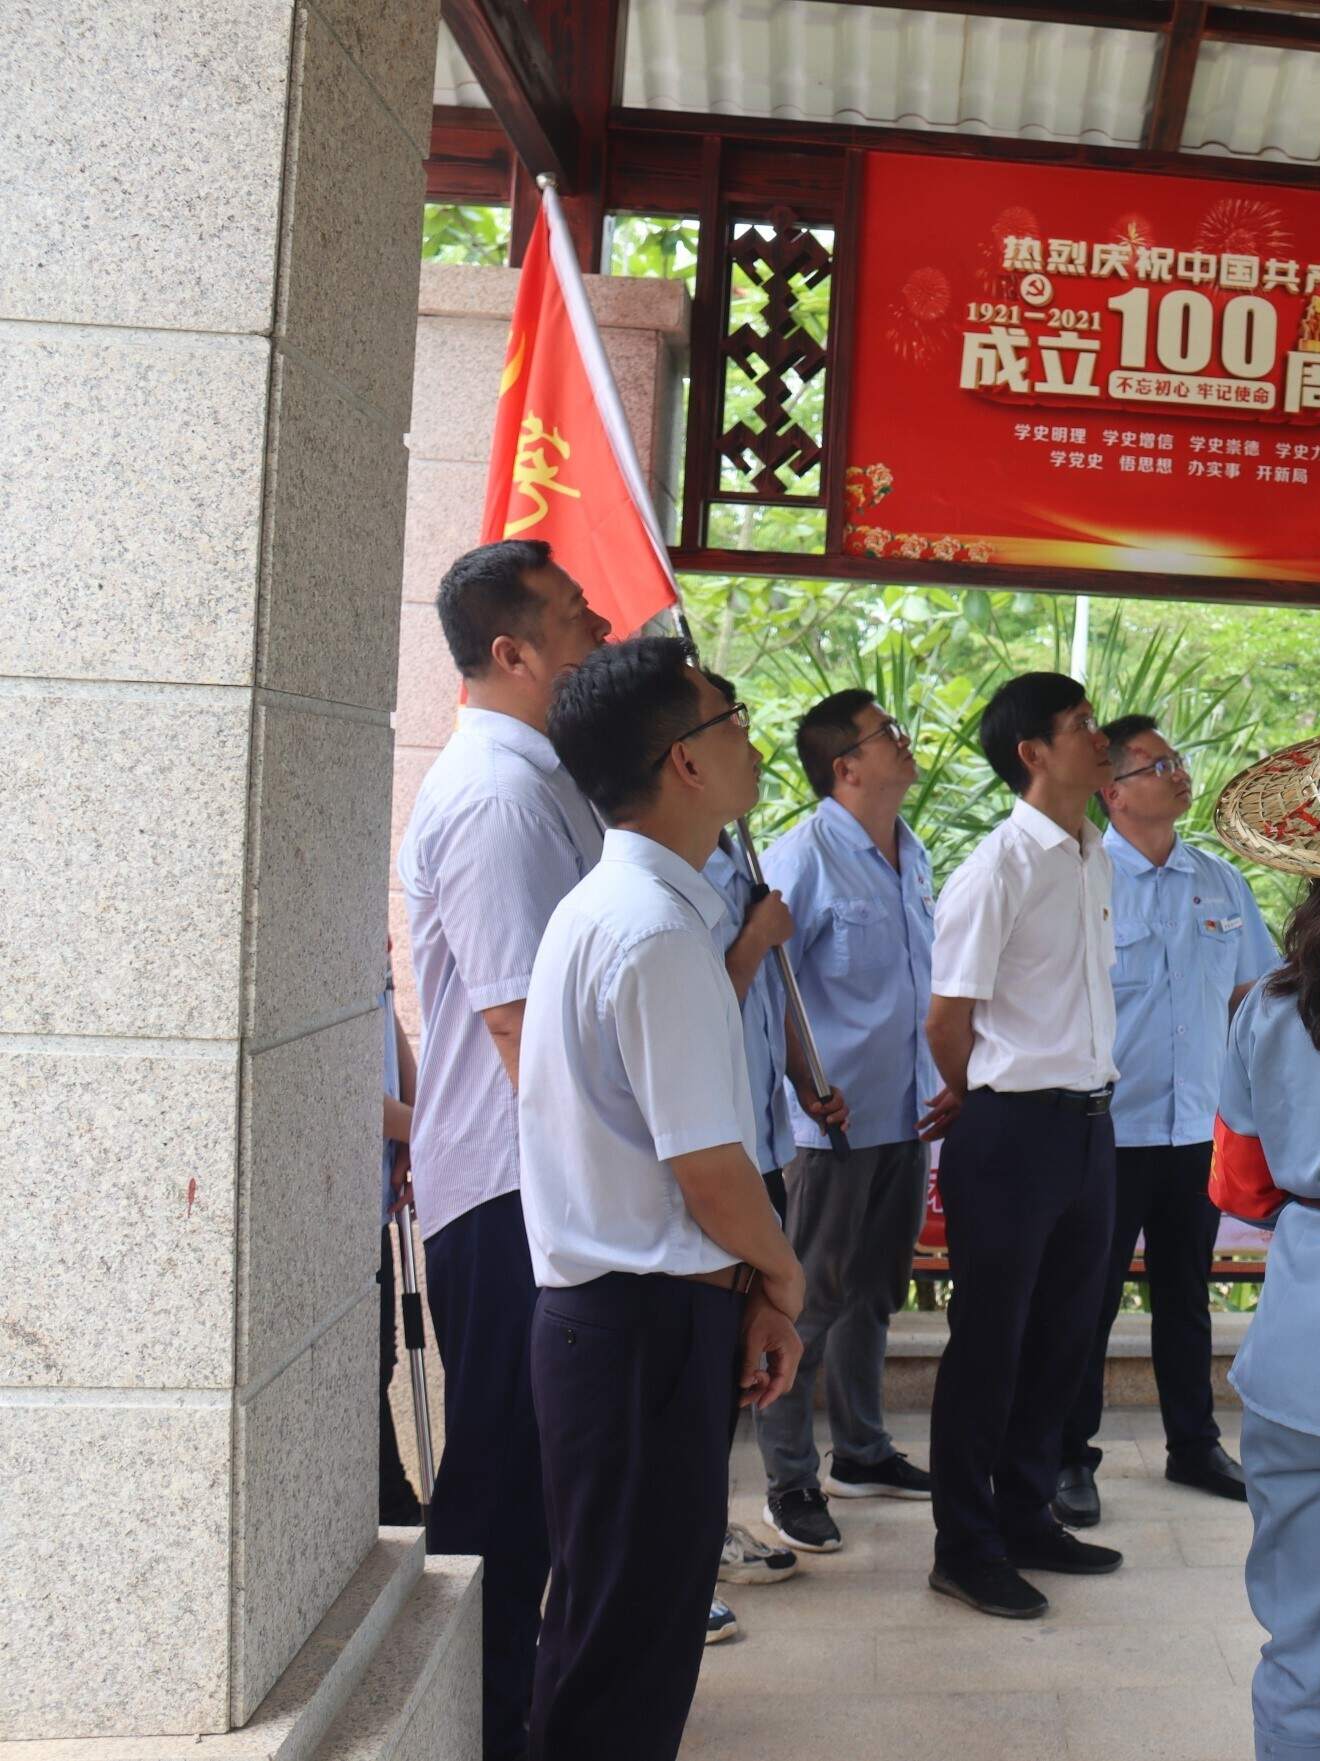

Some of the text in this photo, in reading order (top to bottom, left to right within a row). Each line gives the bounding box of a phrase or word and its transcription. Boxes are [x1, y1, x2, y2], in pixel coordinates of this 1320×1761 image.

[959, 328, 1101, 396] 成立
[1107, 287, 1278, 379] 100
[1116, 376, 1271, 406] 不忘初心 牢记使命
[1014, 423, 1087, 446] 学史明理
[1102, 428, 1175, 451] 学史增信
[1190, 435, 1261, 457] 学史崇德
[1050, 449, 1308, 485] 学党史 悟思想 办实事 开新局
